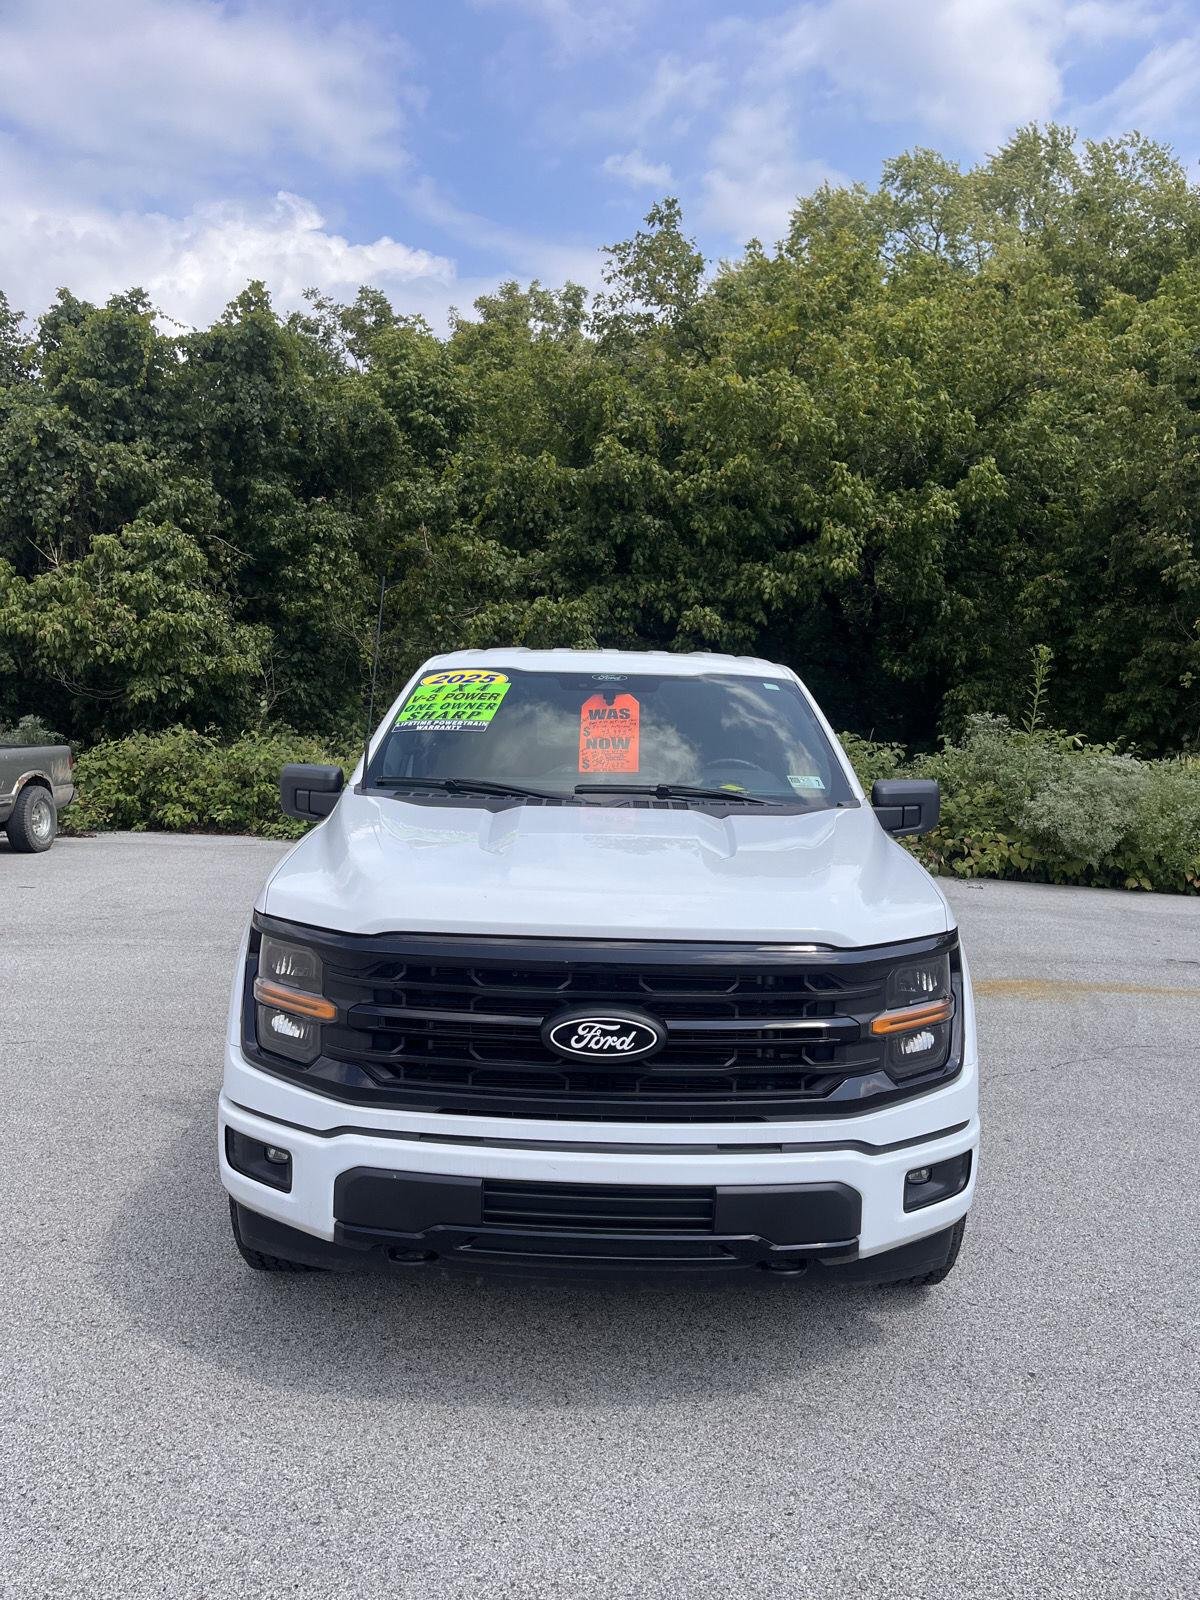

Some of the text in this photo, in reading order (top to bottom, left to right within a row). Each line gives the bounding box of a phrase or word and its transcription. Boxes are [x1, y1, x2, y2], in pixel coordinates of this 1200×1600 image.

[428, 674, 501, 685] 2025
[442, 692, 502, 701] POWER
[404, 702, 499, 712] ONE OWNER
[406, 711, 482, 720] SHARP
[588, 708, 631, 720] WAS
[585, 737, 631, 750] NOW
[570, 1022, 637, 1050] Ford
